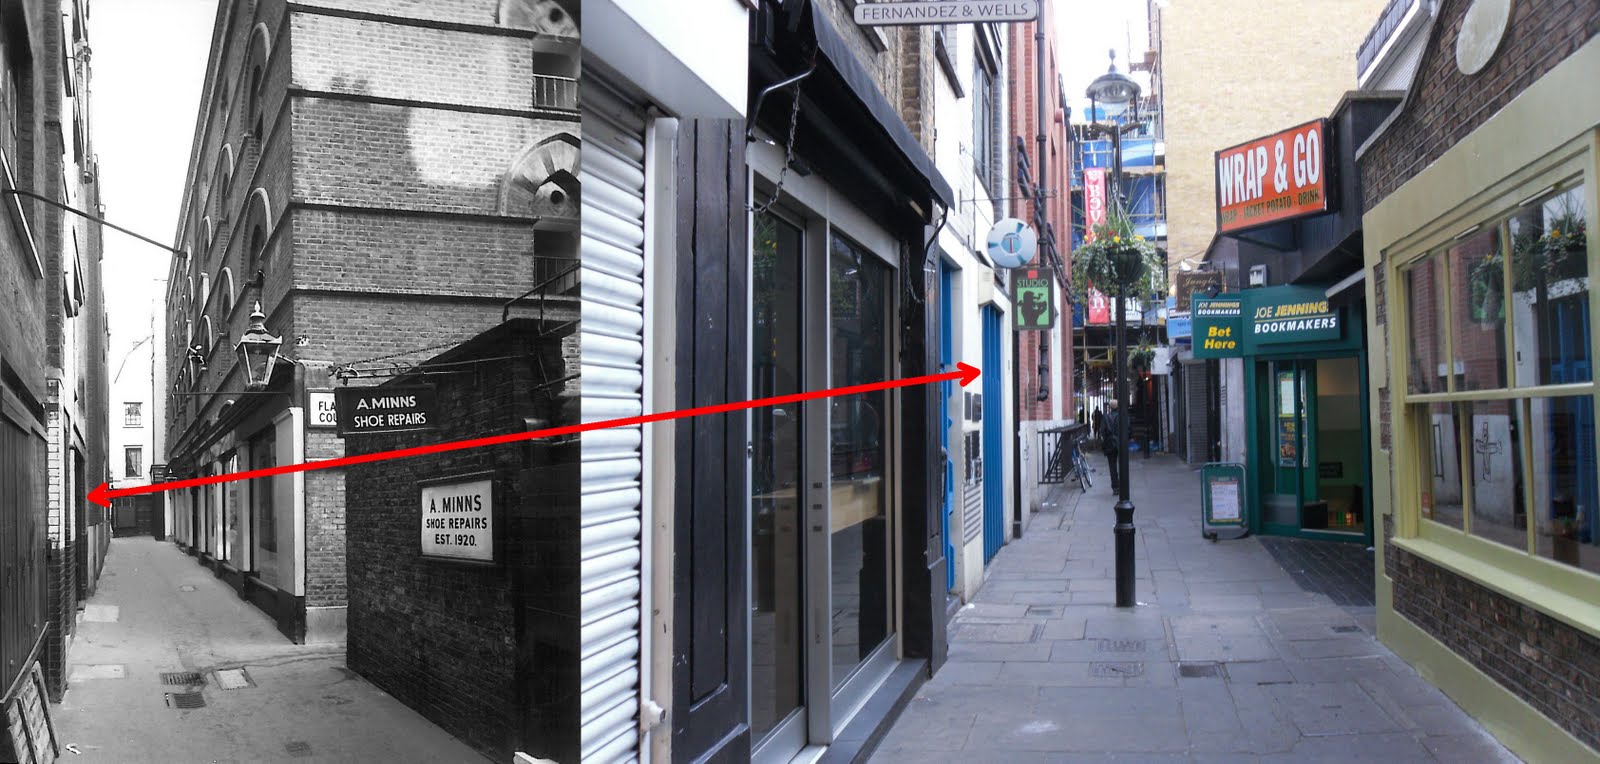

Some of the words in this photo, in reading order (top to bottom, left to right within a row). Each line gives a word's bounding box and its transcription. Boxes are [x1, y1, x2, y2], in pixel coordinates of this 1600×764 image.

[862, 5, 958, 20] FERNANDEZ
[961, 6, 973, 17] &
[978, 3, 1028, 17] WELLS
[1219, 145, 1268, 207] WRAP
[1274, 139, 1288, 193] &
[1293, 128, 1320, 188] GO
[1267, 196, 1291, 213] POTATO
[1298, 189, 1320, 205] DRINK
[1016, 279, 1048, 287] STUDIO
[1254, 306, 1273, 319] JOE
[1208, 326, 1231, 337] Bet
[1254, 317, 1336, 334] BOOKMAKERS
[1204, 339, 1236, 349] Here
[318, 401, 336, 412] FLA
[354, 415, 384, 428] SHOE
[387, 413, 427, 426] REPAIRS
[426, 518, 446, 529] SHOE
[448, 517, 487, 529] REPAIRS
[435, 533, 452, 545] EST.
